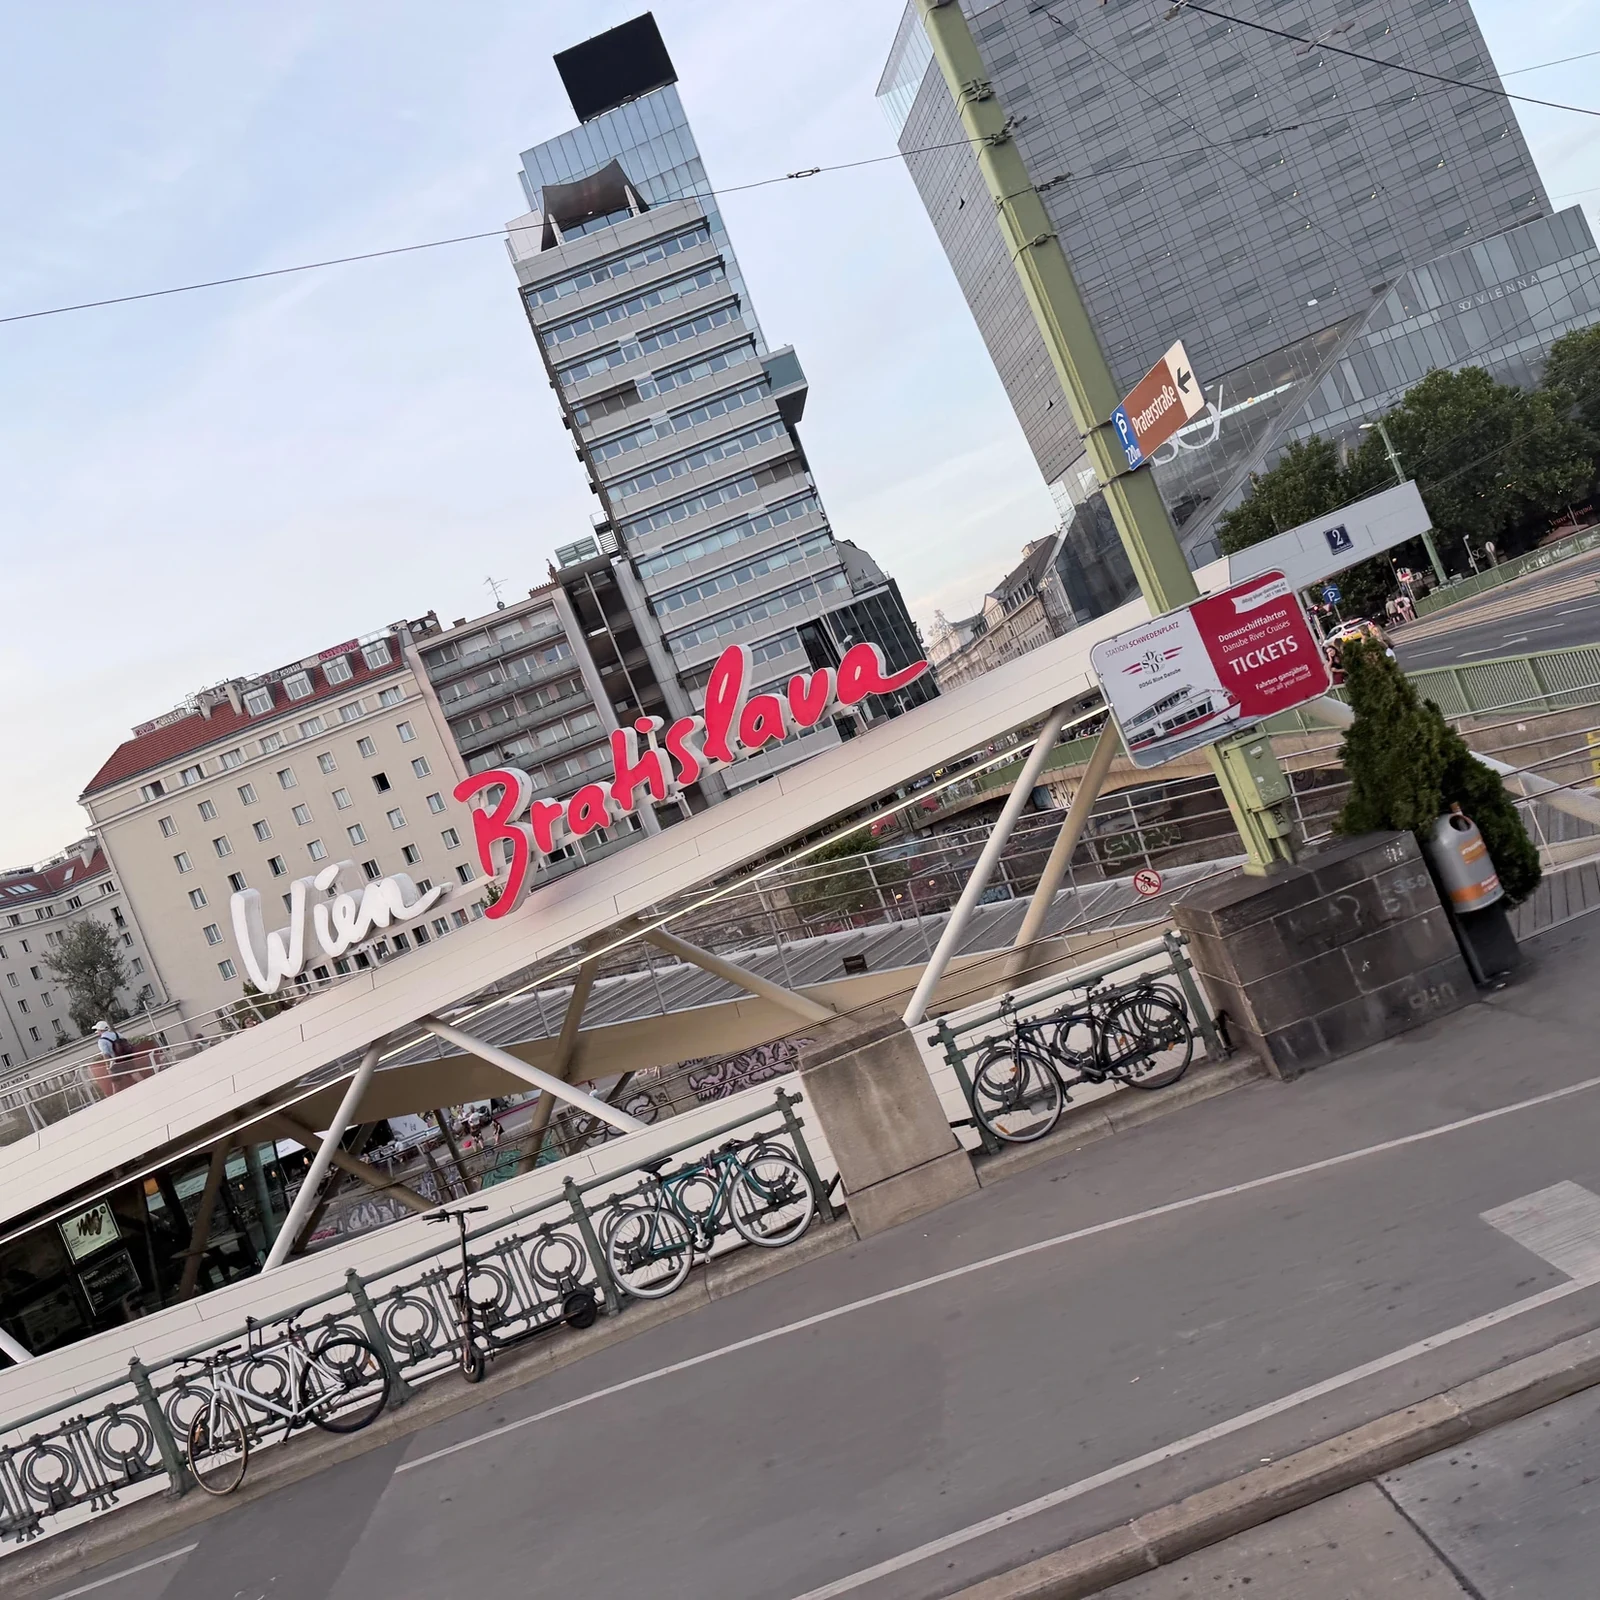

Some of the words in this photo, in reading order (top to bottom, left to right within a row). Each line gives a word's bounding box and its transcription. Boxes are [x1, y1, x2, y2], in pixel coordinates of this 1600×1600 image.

[1476, 275, 1539, 304] VIENNA
[1131, 384, 1177, 438] Praterstraße
[1331, 529, 1344, 546] 2
[1105, 643, 1129, 658] STATION
[1128, 621, 1180, 648] SCHWEDENPLATZ
[1218, 609, 1287, 643] Donauschifffahrten
[1222, 637, 1249, 653] Danube
[1249, 630, 1266, 642] River
[1266, 620, 1291, 634] Cruises
[1228, 635, 1298, 676] TICKETS
[1152, 675, 1163, 683] Blue
[1163, 668, 1181, 679] Danube
[1255, 676, 1278, 690] Fahrten
[452, 642, 929, 920] Bratislava
[230, 863, 443, 994] Wien
